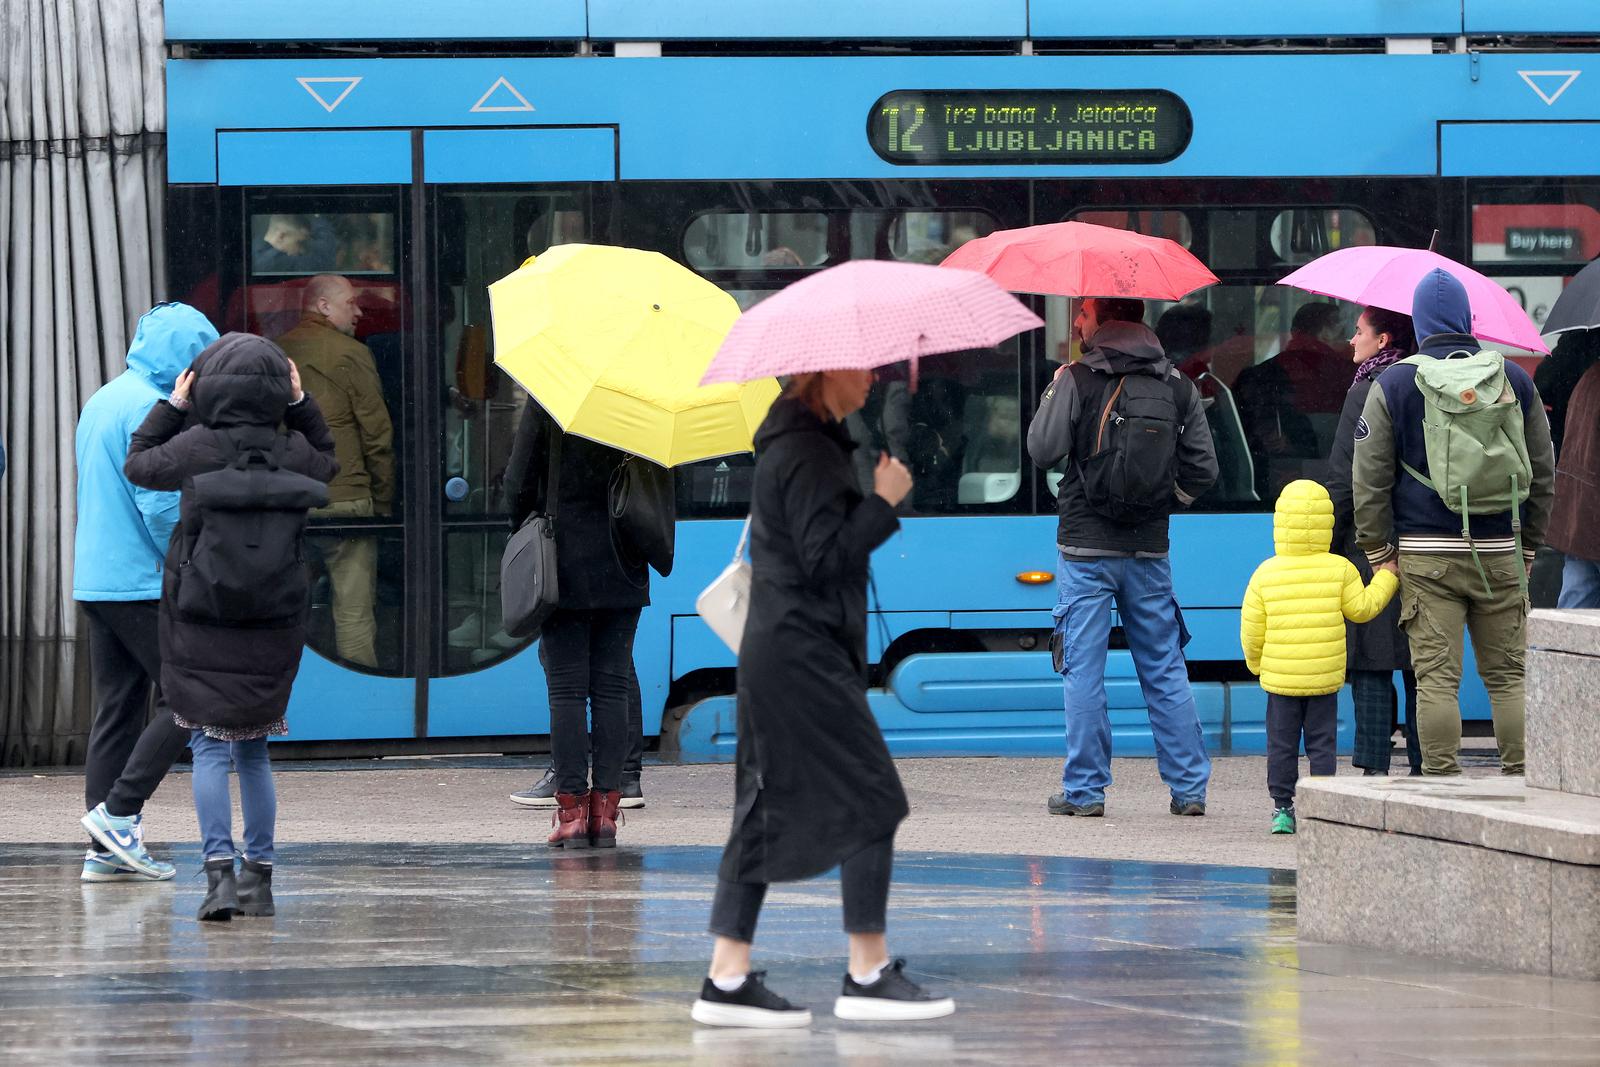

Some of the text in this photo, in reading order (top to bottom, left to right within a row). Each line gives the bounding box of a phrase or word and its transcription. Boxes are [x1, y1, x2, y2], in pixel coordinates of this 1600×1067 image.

[882, 102, 925, 152] 12
[947, 130, 1156, 151] LJUBLJANICA
[1511, 231, 1573, 251] Buy here
